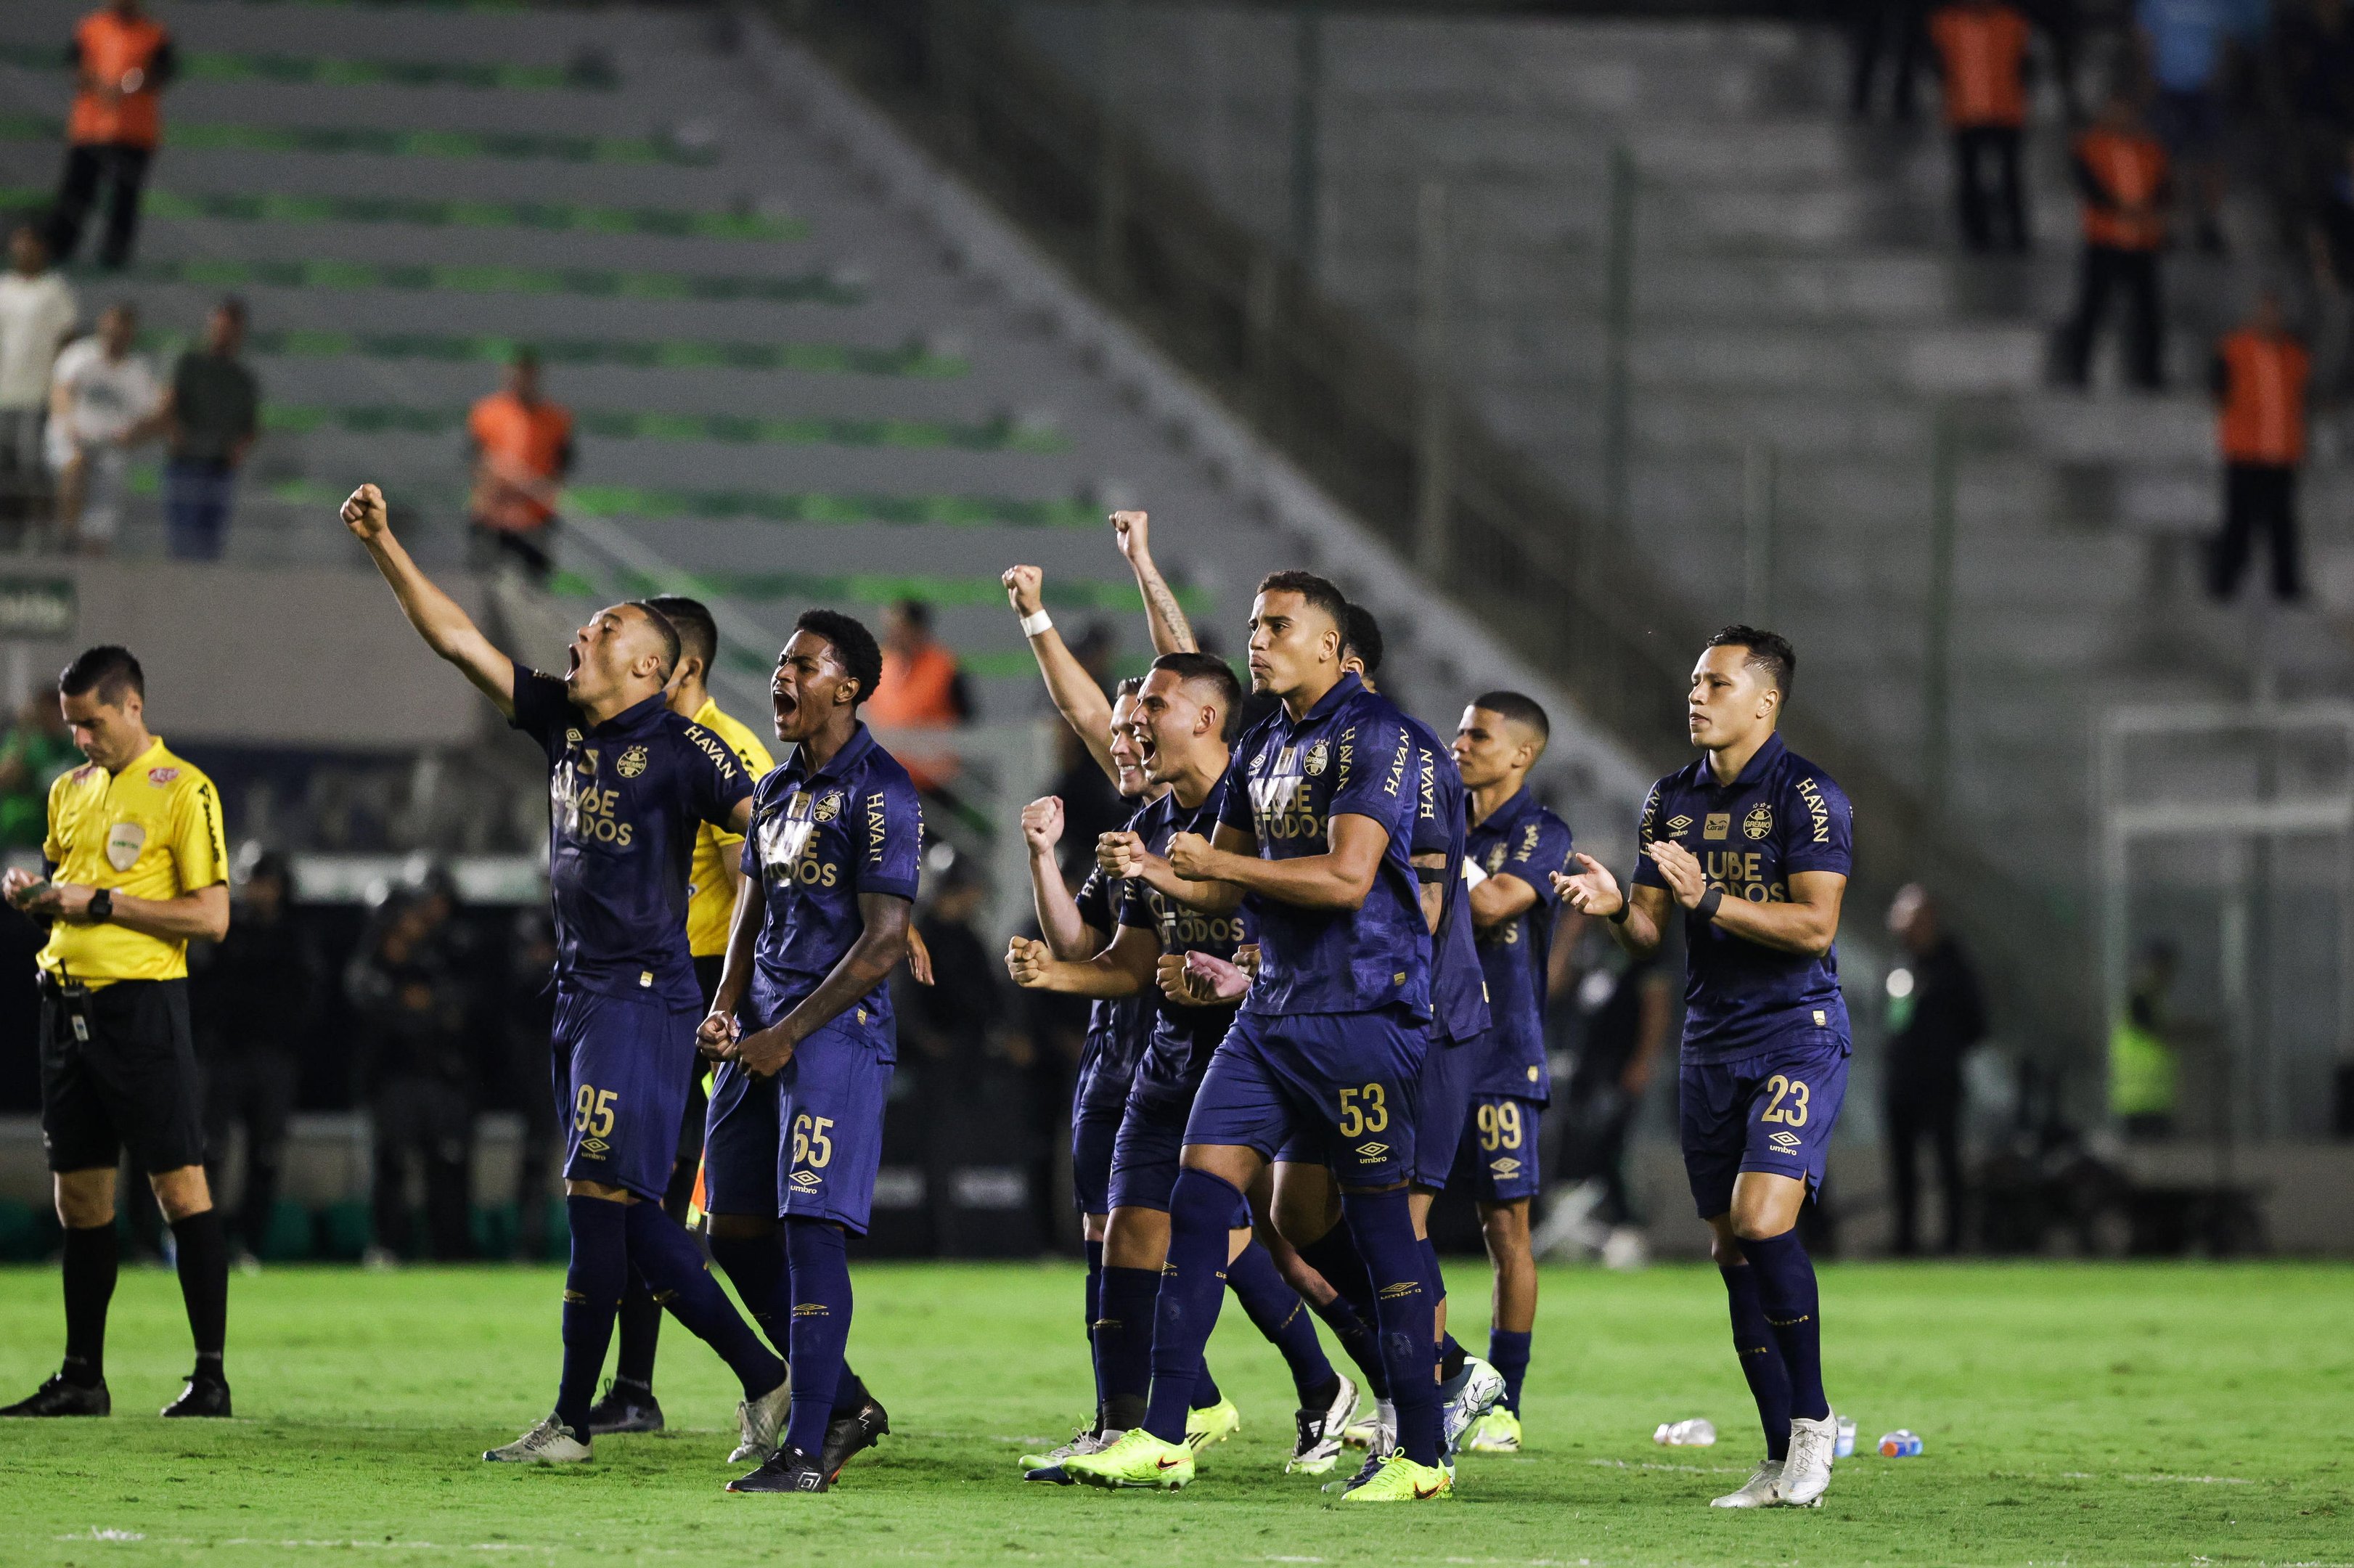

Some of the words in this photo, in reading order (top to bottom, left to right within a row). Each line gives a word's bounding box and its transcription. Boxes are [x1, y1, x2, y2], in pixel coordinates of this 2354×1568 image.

[684, 725, 737, 780] HAVAN
[1337, 726, 1355, 792] HAVAN
[1384, 727, 1410, 797] HAVAN
[1420, 748, 1435, 820] HAVAN
[1795, 777, 1829, 843] HAVAN
[867, 791, 885, 862] HAVAN
[1692, 851, 1762, 881] UBE
[574, 1084, 618, 1138] 95
[1339, 1083, 1388, 1138] 53
[1477, 1101, 1522, 1151] 99
[1761, 1074, 1810, 1127] 23
[581, 1151, 605, 1161] umbro
[793, 1114, 834, 1168] 65
[1360, 1155, 1387, 1164] umbro
[1770, 1144, 1797, 1156] umbro
[790, 1184, 817, 1194] umbro
